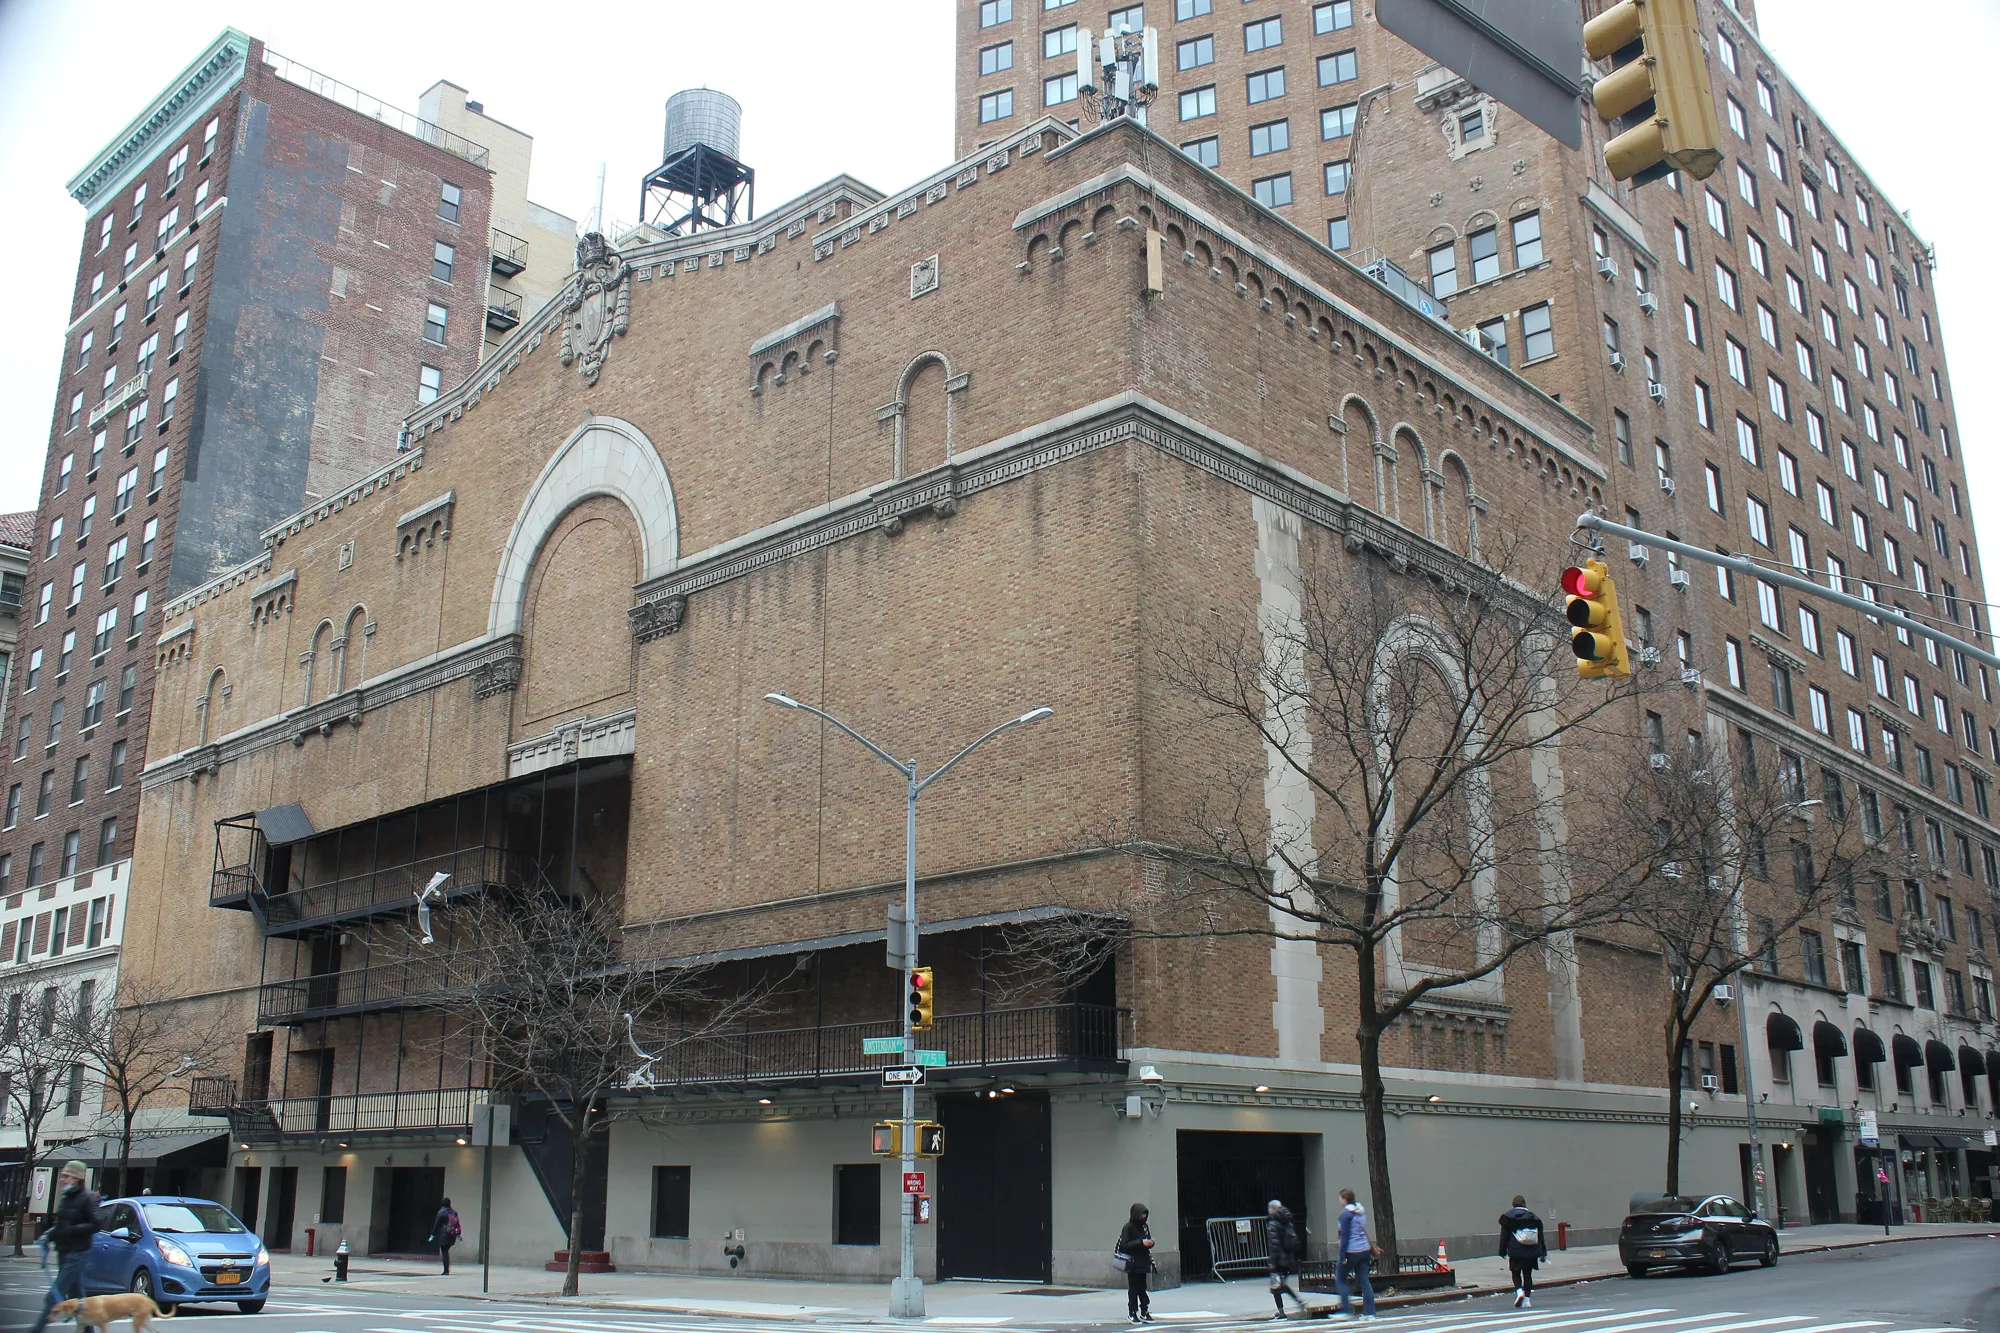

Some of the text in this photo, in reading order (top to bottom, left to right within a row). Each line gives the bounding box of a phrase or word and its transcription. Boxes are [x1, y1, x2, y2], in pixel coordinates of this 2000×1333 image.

[864, 1040, 896, 1052] AMSTERDAM
[924, 1053, 937, 1065] 75
[888, 1071, 919, 1080] ONE WAY
